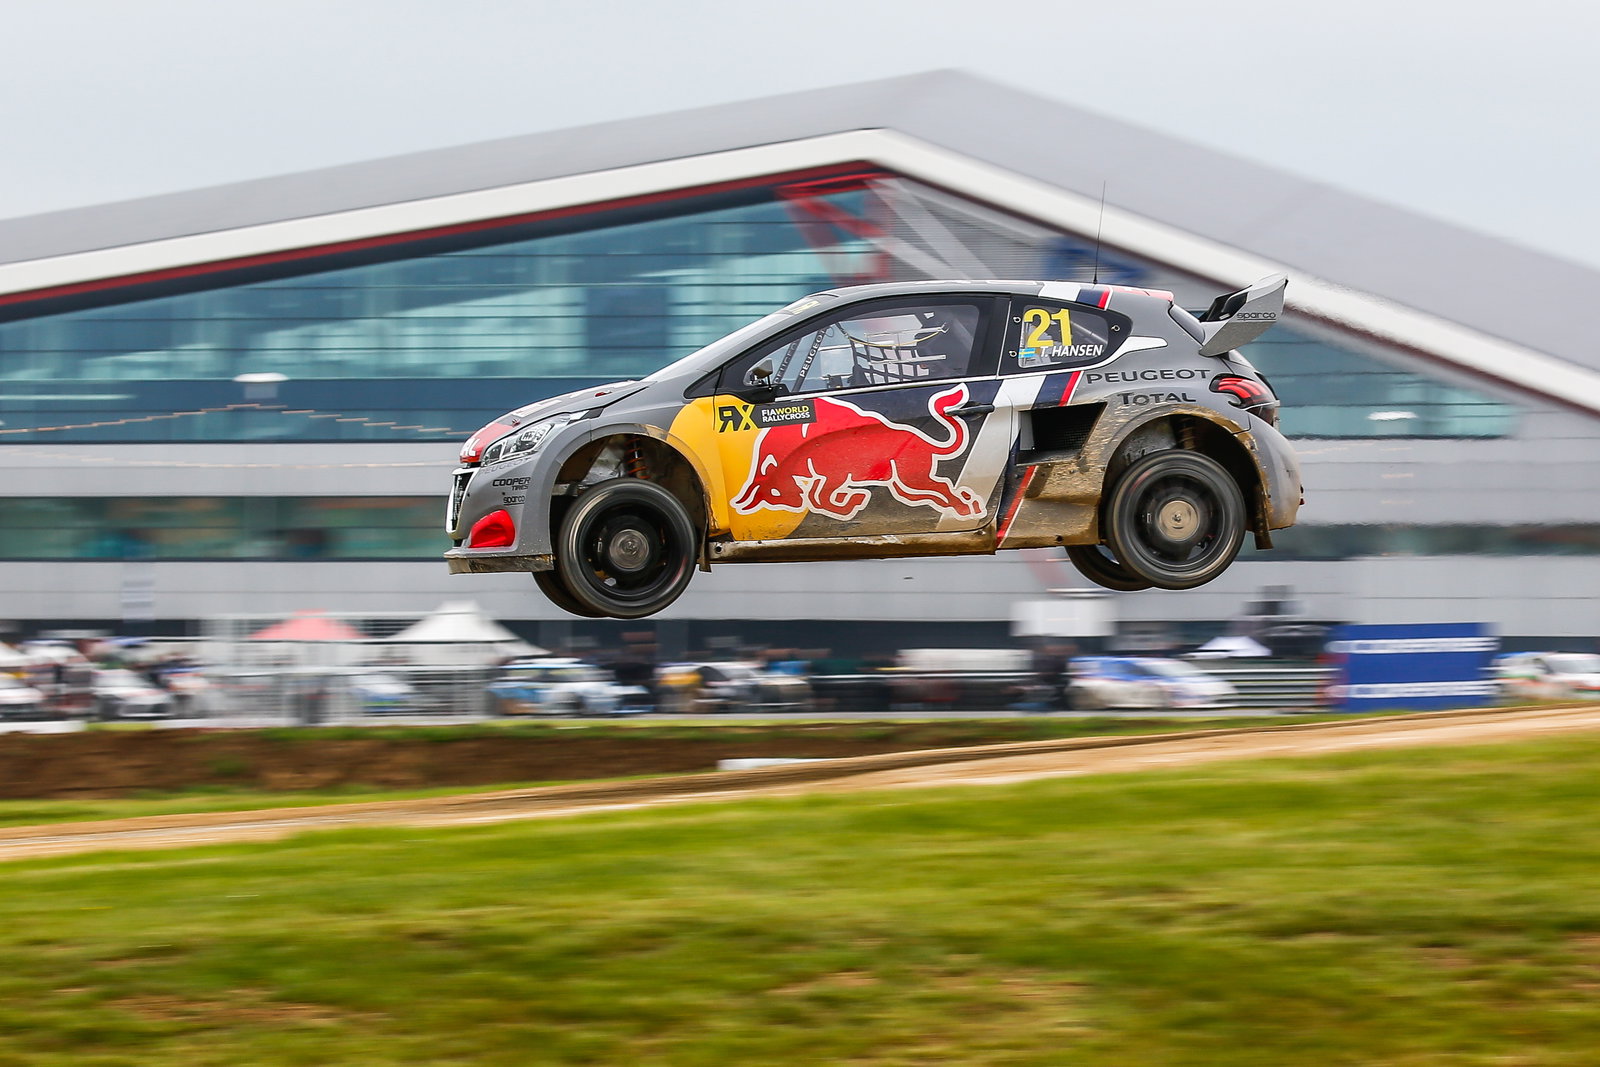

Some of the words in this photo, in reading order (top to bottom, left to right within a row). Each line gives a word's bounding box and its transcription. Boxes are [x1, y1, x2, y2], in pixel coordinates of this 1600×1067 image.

[1236, 312, 1277, 321] sparco
[1023, 308, 1073, 347] 21
[1040, 345, 1048, 358] T.
[1052, 344, 1103, 358] HANSEN
[1086, 369, 1210, 384] PEUGEOT
[1117, 392, 1197, 406] TOTAL
[762, 411, 811, 423] RALLYCROSS
[492, 477, 531, 487] COOPER
[503, 495, 525, 504] sparco
